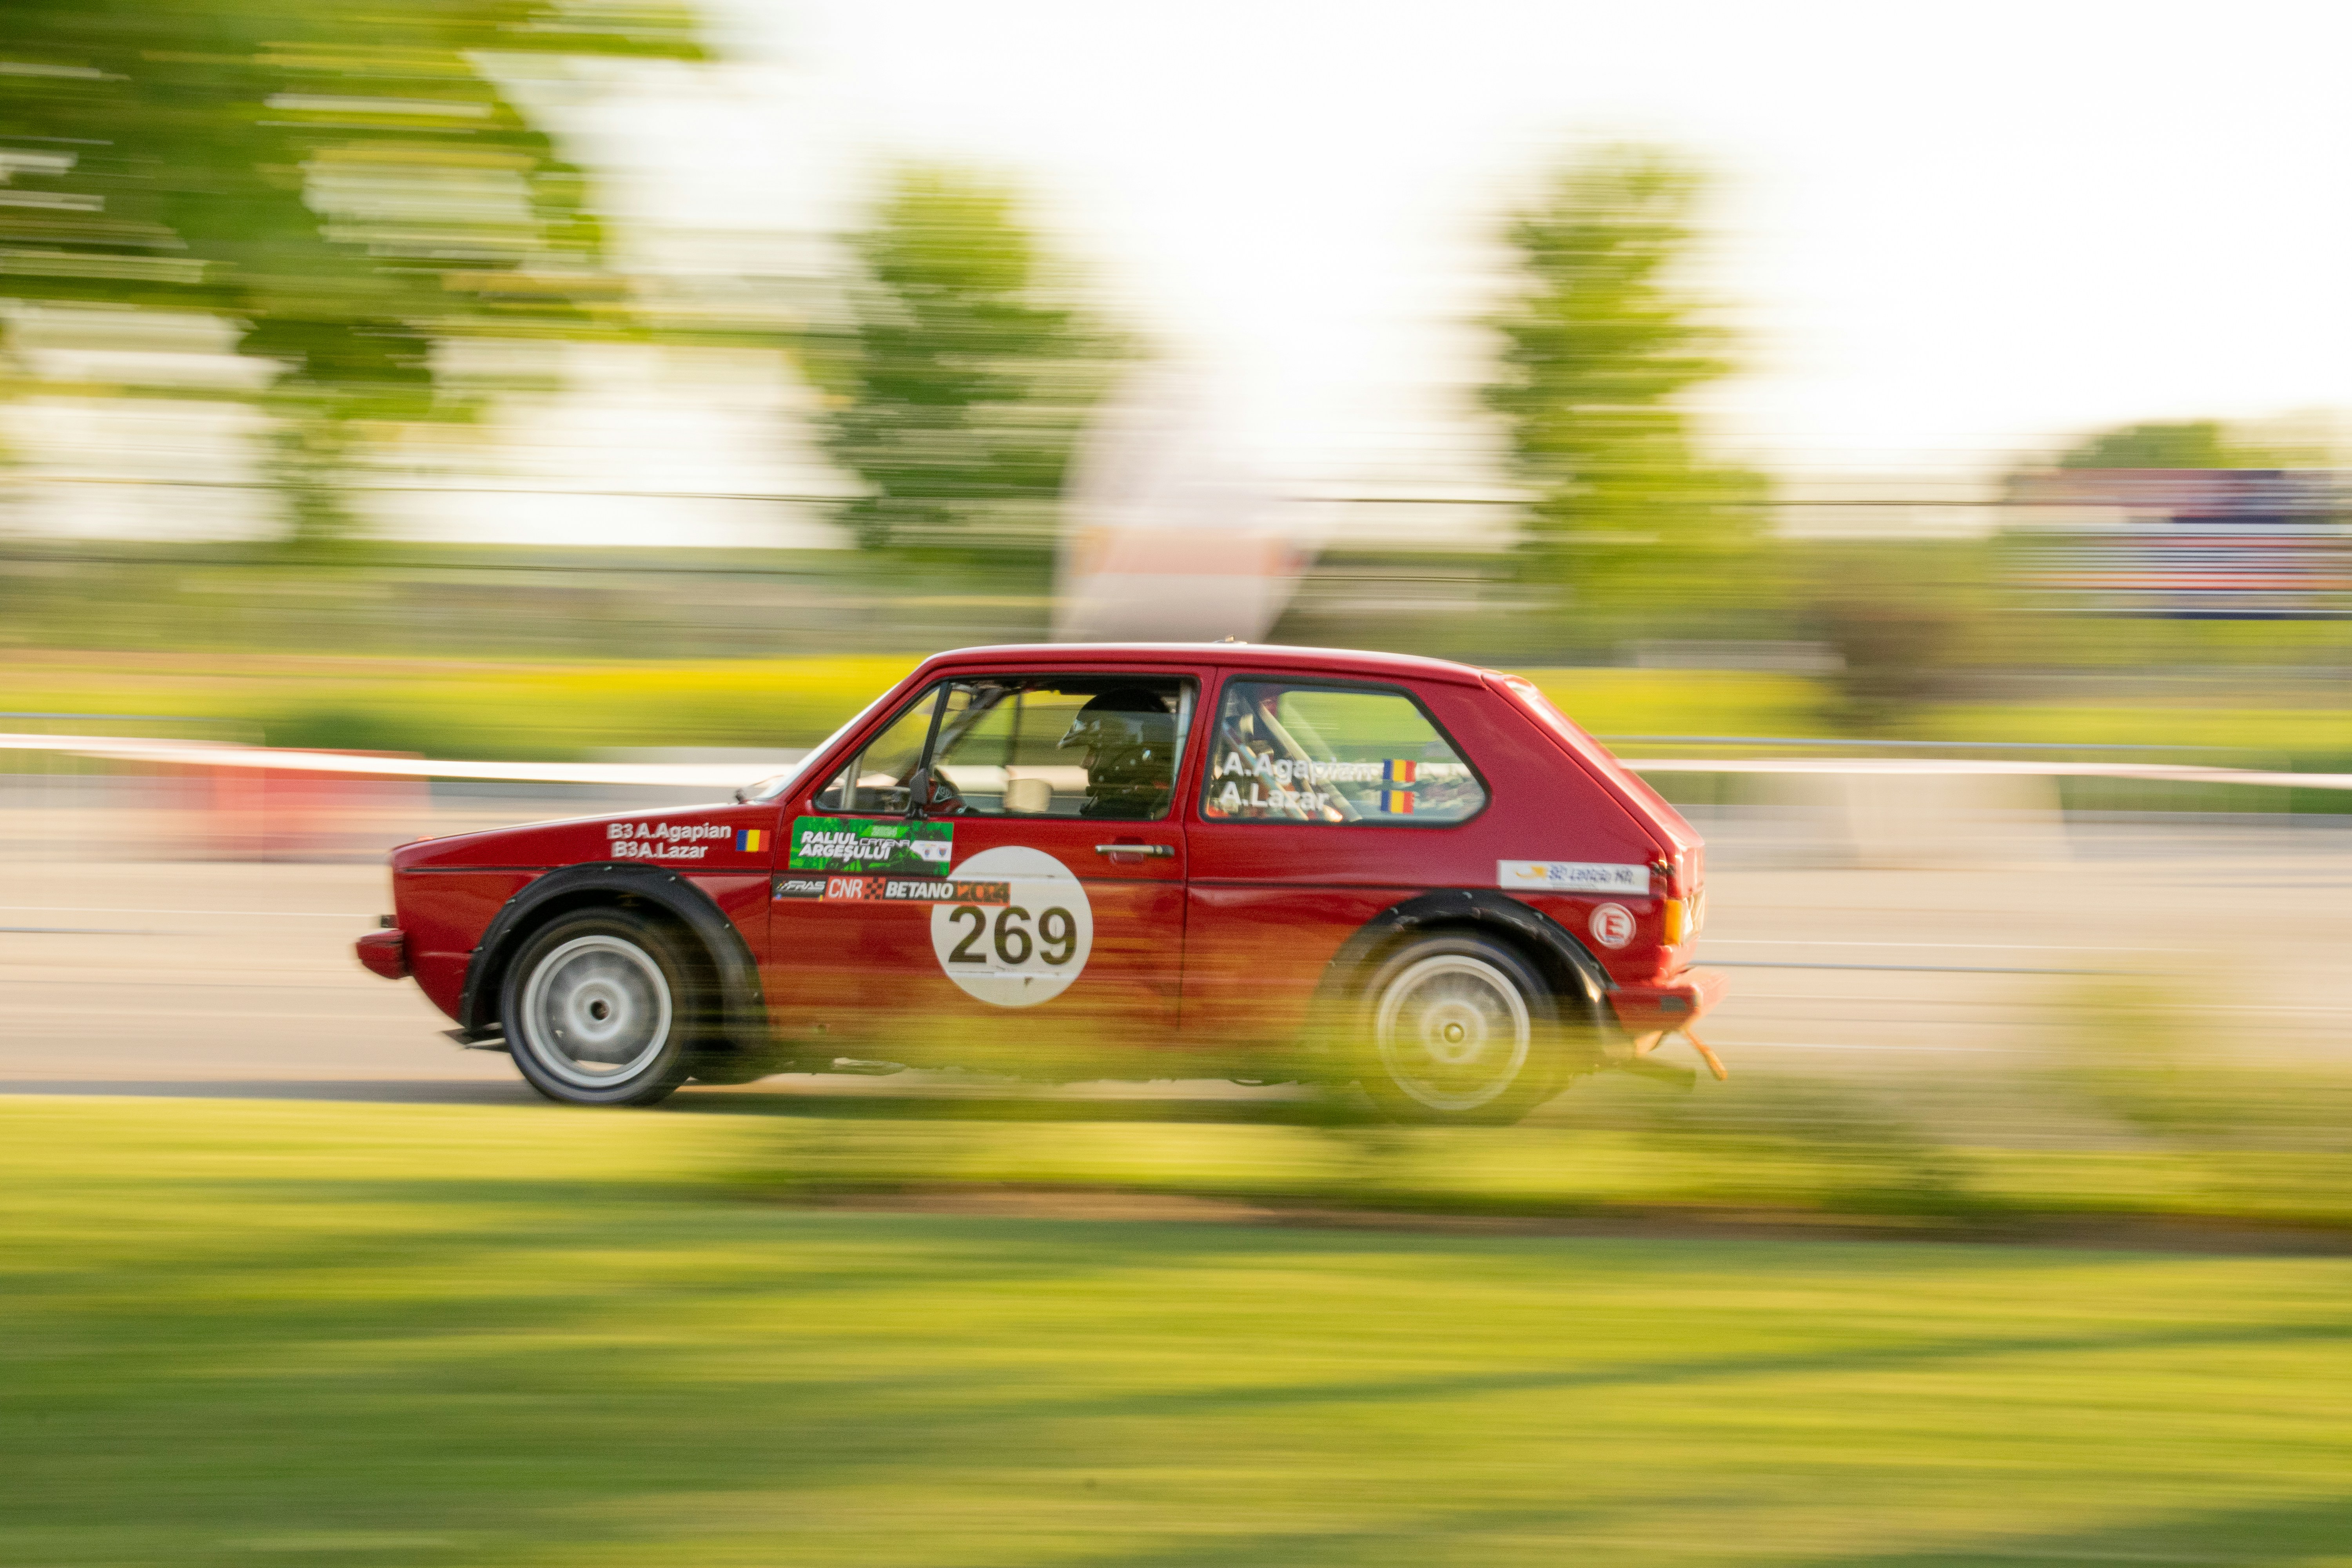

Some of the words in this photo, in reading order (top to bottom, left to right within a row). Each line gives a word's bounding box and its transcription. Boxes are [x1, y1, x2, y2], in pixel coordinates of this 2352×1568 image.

[1220, 781, 1330, 811] A.Lazar
[801, 830, 858, 845] RALIUL
[828, 878, 863, 898] CNR
[885, 881, 954, 899] BETANO
[948, 905, 1077, 965] 269
[1604, 913, 1624, 938] E
